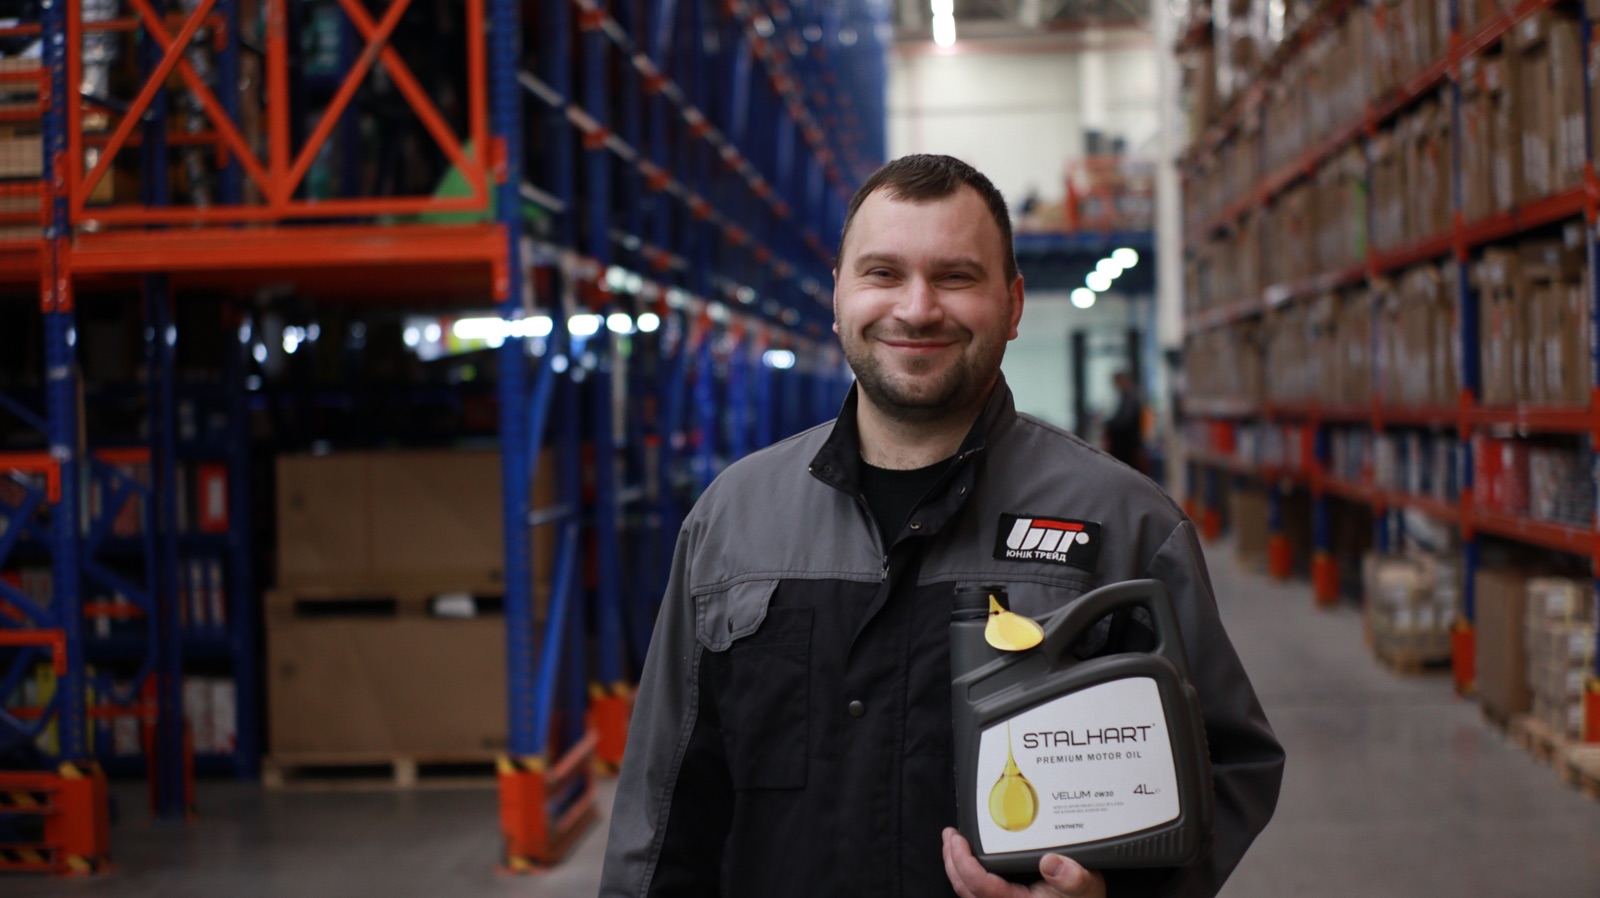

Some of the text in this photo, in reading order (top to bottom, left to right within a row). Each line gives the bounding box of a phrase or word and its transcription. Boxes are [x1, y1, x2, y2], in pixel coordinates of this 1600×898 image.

[1006, 549, 1066, 562] ЮНІК ТРЕЙД
[1023, 726, 1151, 749] STALHART
[1036, 750, 1142, 765] PREMIUM MOTOR OIL
[1052, 790, 1091, 801] VELUM
[1133, 784, 1155, 795] 4L
